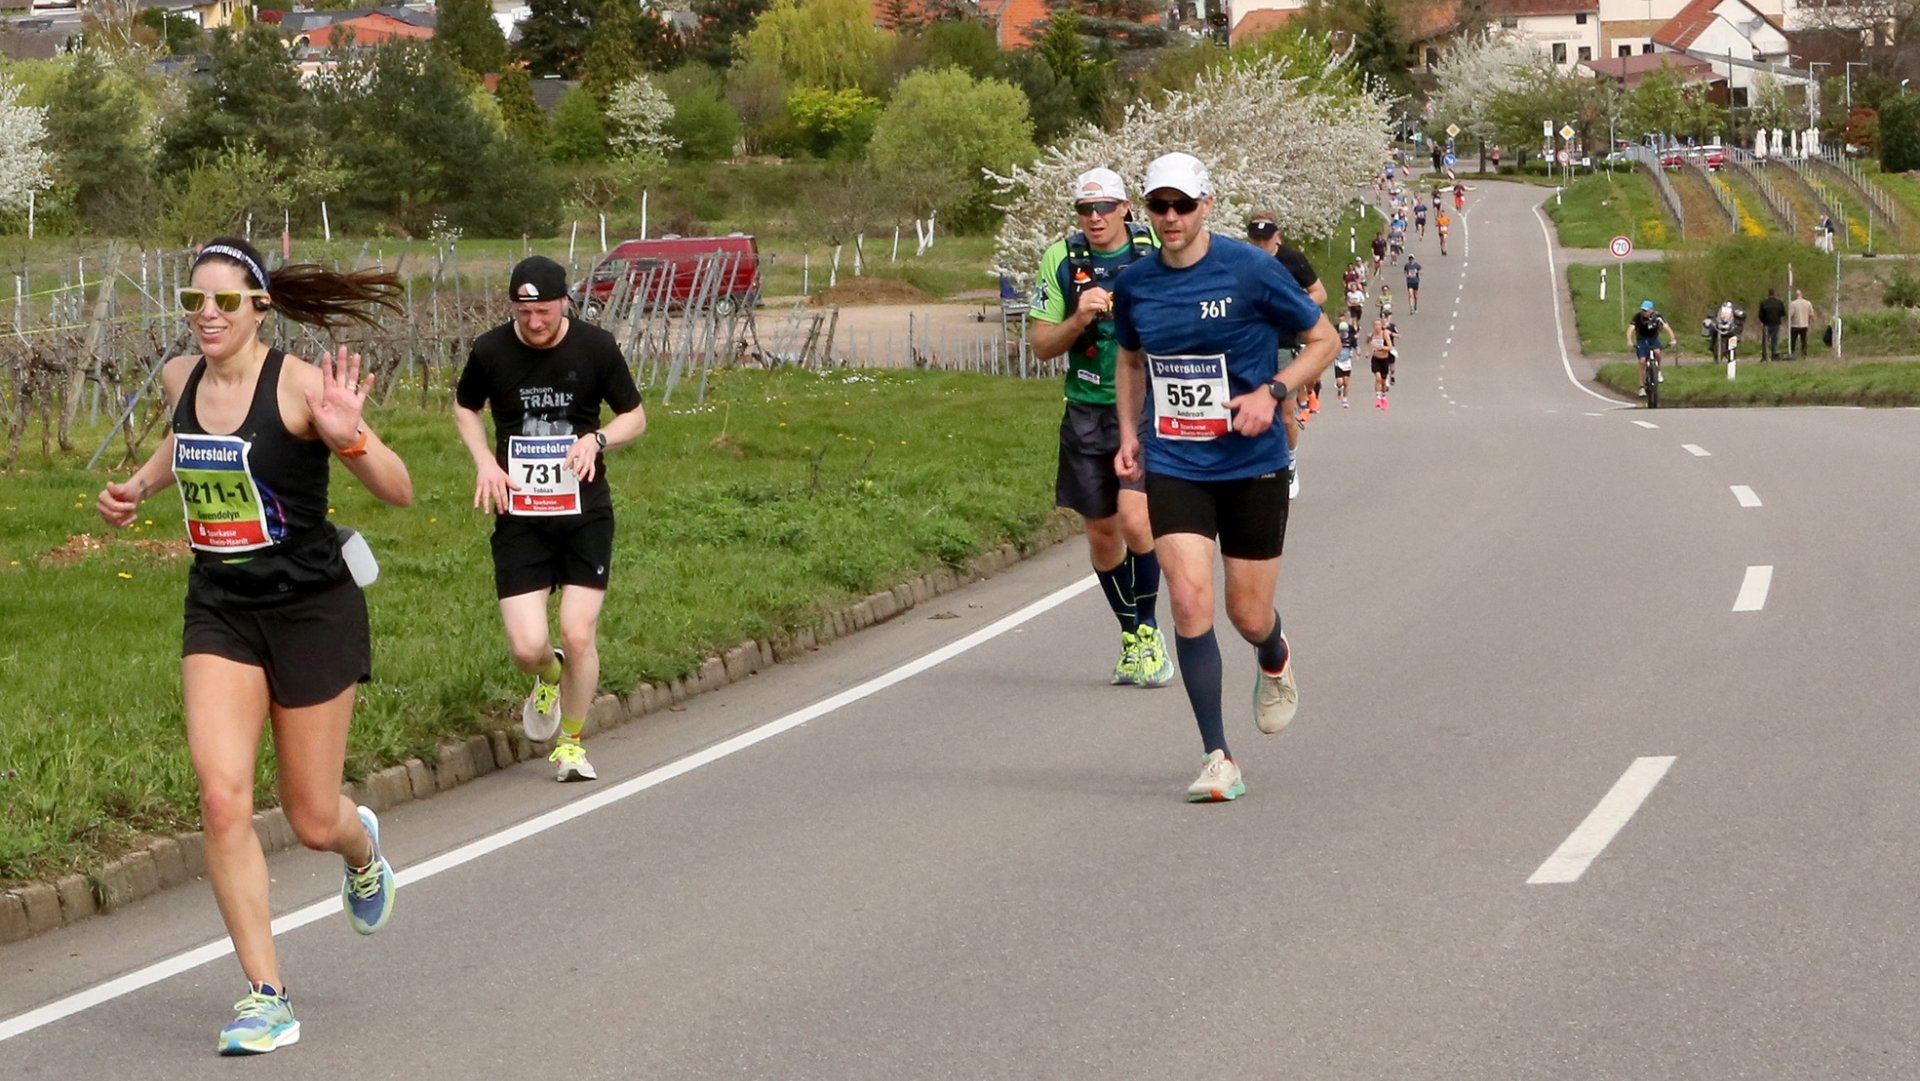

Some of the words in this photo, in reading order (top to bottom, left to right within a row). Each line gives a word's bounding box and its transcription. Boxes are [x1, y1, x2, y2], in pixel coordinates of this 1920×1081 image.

[1615, 242, 1627, 252] 70
[1155, 362, 1217, 374] Peterstaler
[520, 387, 553, 395] Sachsen
[1167, 383, 1213, 407] 552
[179, 443, 238, 463] Peterstaler
[514, 442, 570, 455] Peterstaler
[522, 464, 561, 484] 731
[182, 481, 249, 505] 2211-1
